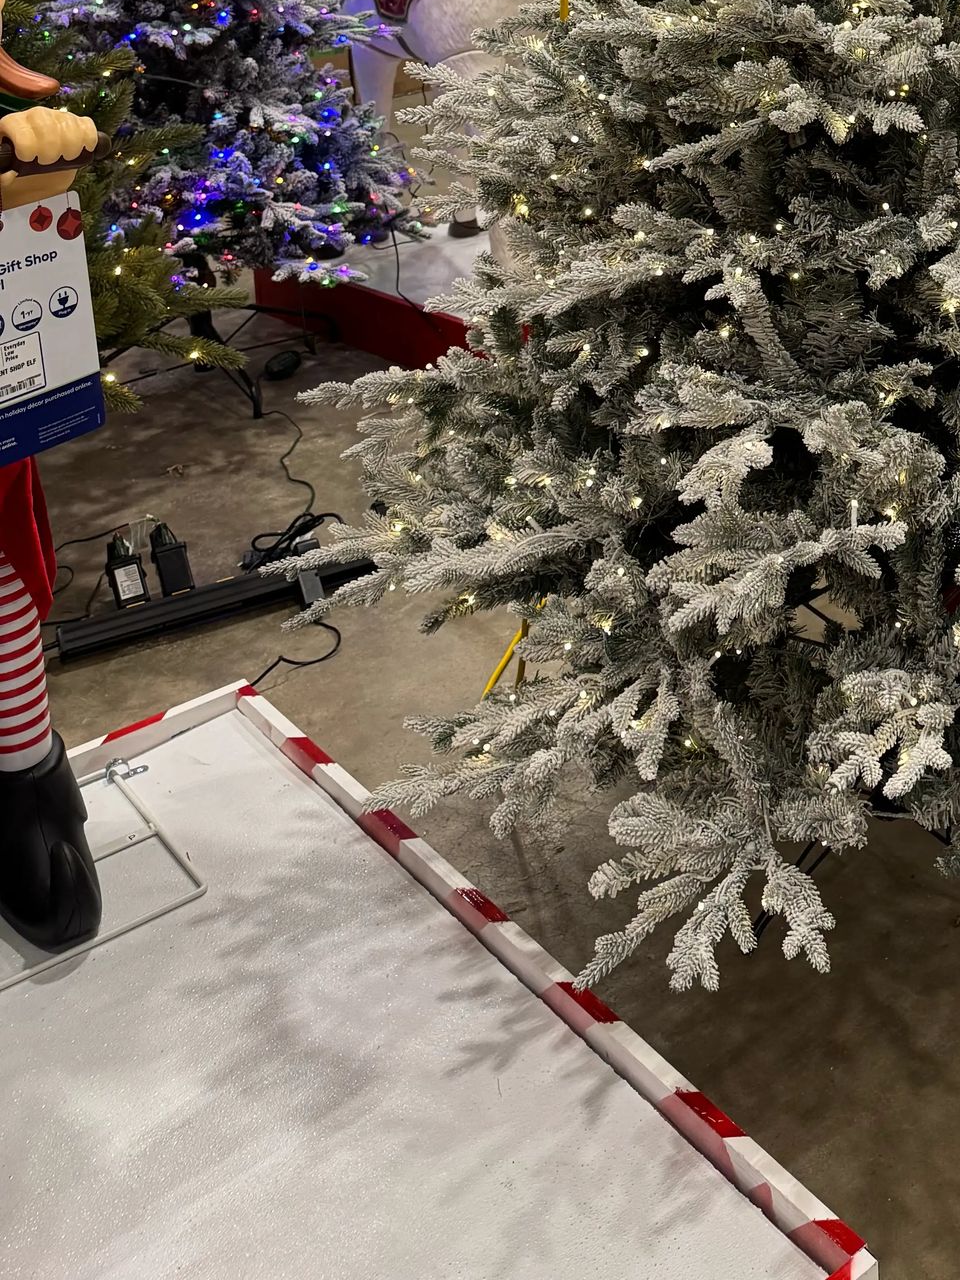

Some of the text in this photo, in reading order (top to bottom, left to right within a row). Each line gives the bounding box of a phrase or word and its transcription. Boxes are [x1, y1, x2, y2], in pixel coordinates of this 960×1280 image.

[25, 251, 58, 267] Shop
[3, 340, 26, 352] Everyday
[5, 354, 19, 363] Price
[9, 363, 25, 373] SHOP
[26, 358, 37, 367] ELF
[4, 406, 27, 418] holiday
[27, 399, 44, 410] décor
[44, 387, 75, 404] purchased
[74, 381, 93, 393] online.
